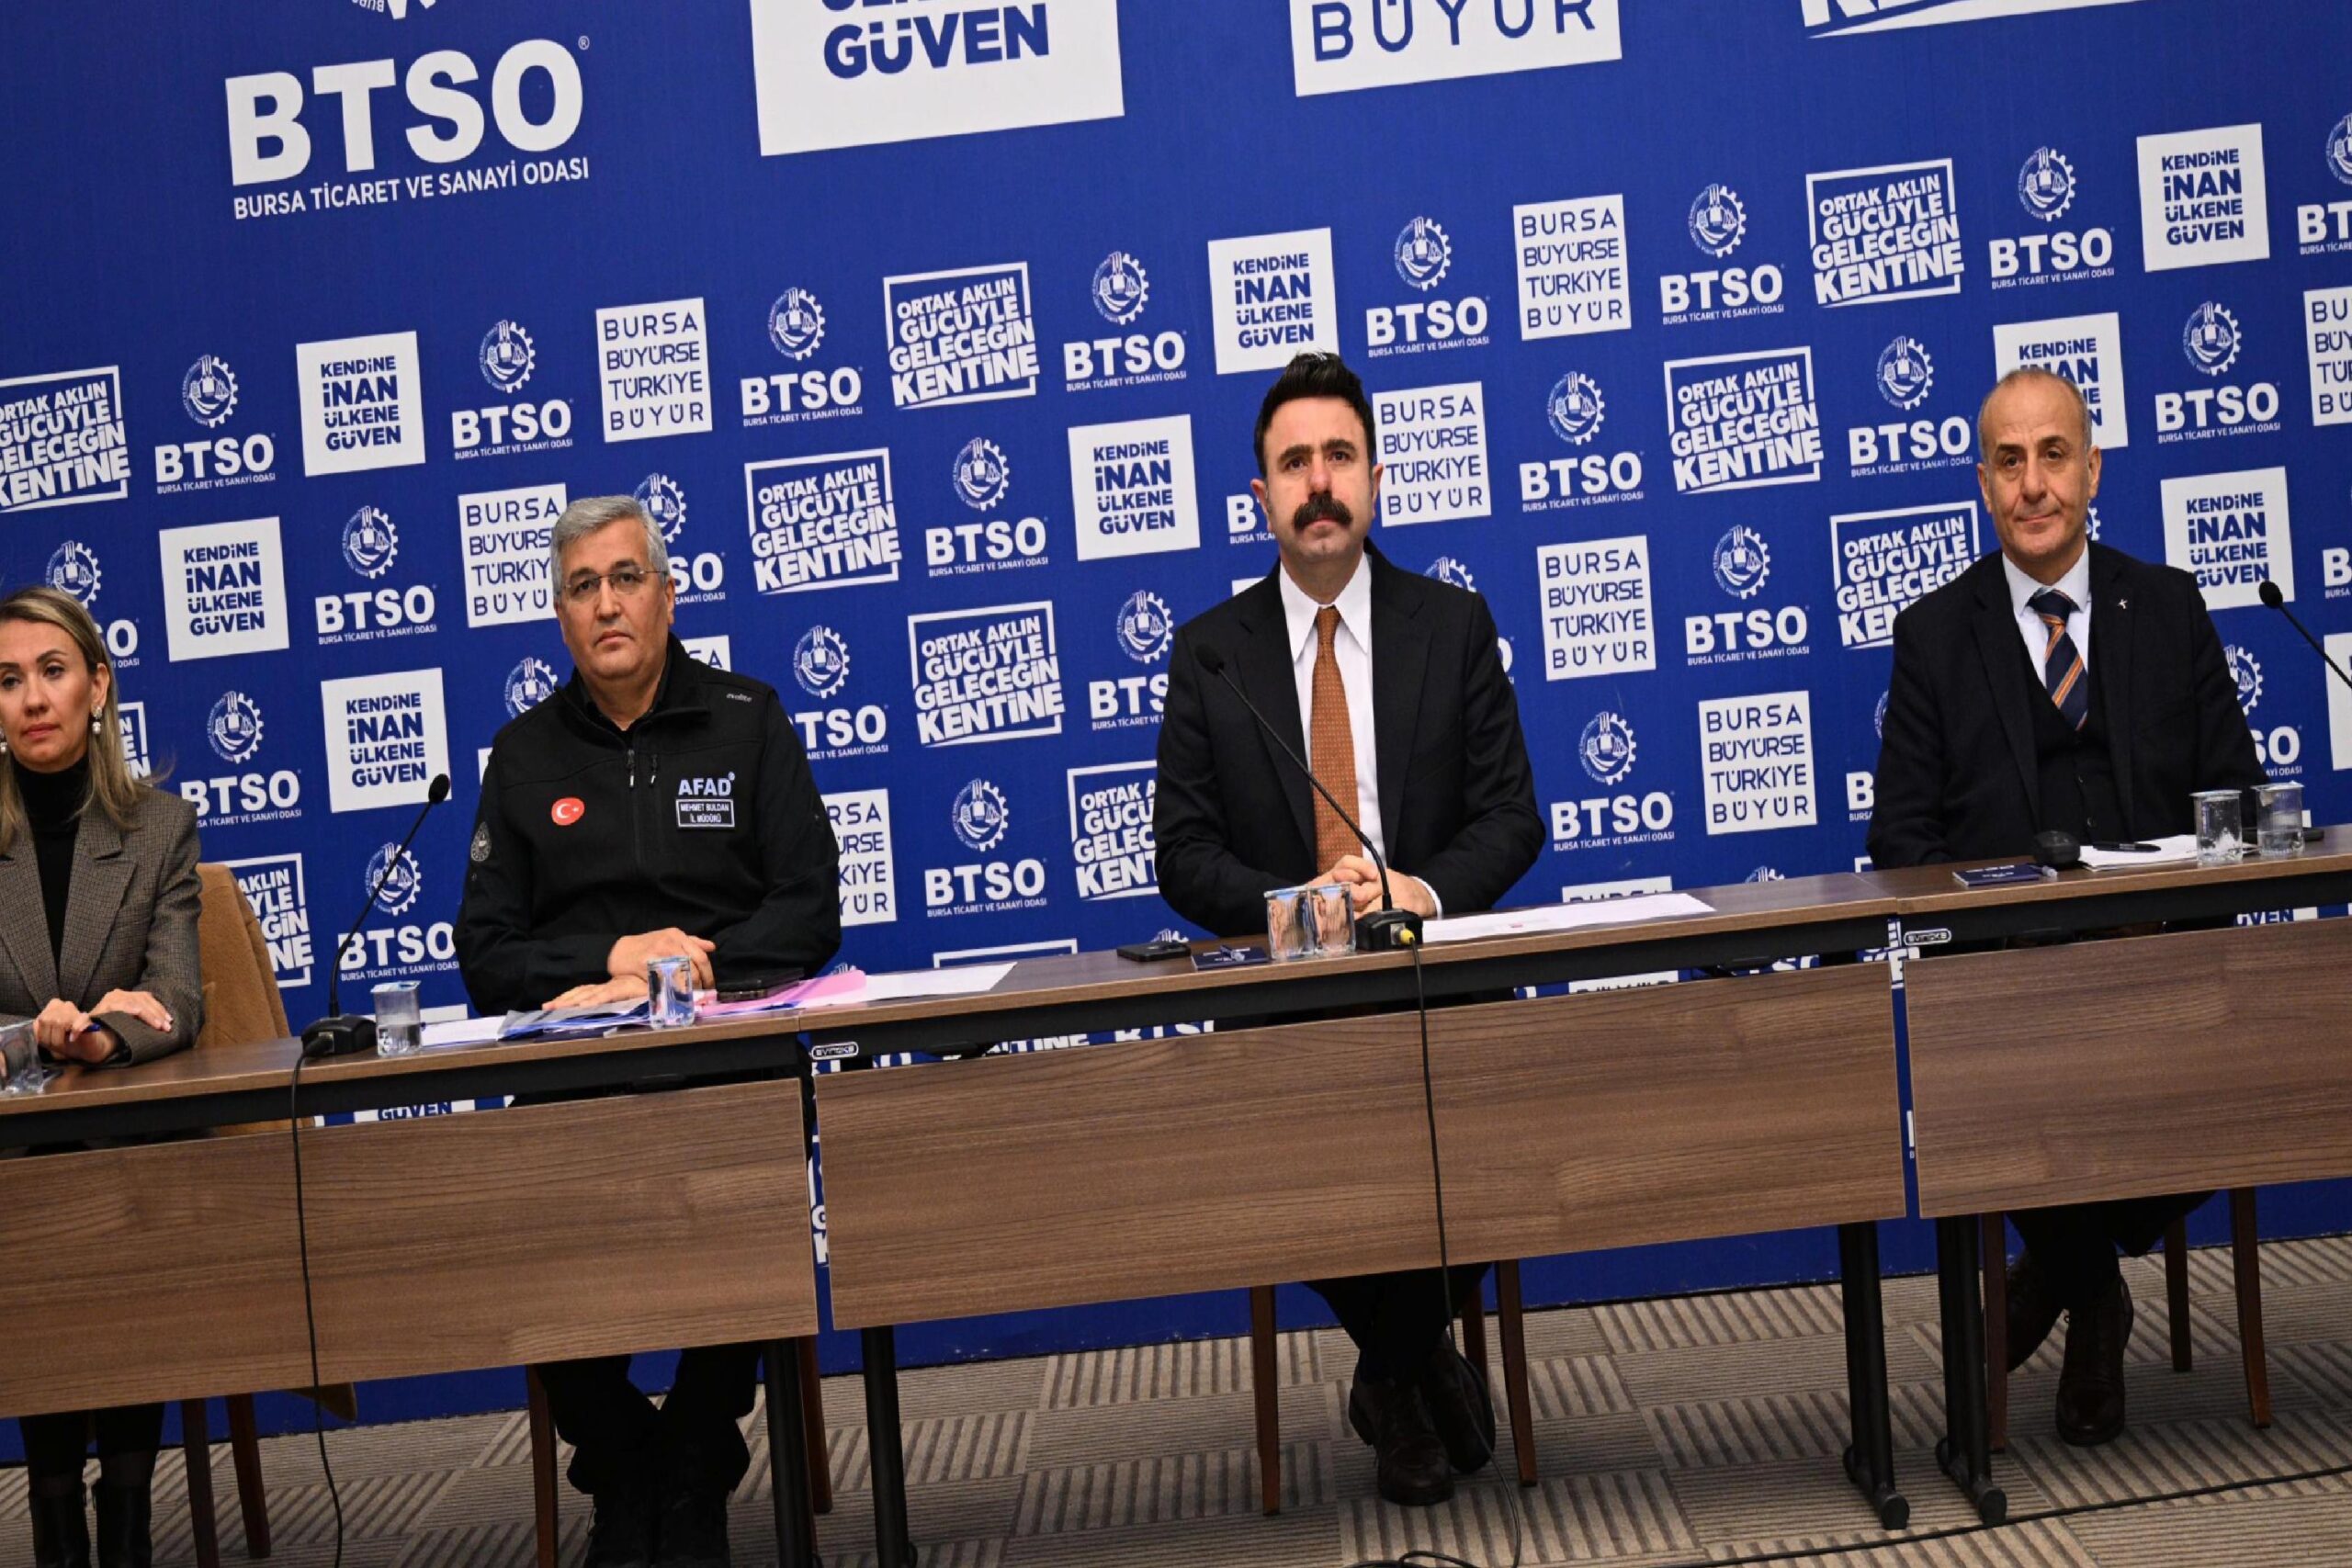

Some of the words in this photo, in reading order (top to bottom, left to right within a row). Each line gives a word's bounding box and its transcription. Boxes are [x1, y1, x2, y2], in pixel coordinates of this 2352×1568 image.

[824, 3, 1049, 79] GÜVEN
[225, 39, 583, 186] BTSO
[234, 192, 306, 220] BURSA
[311, 178, 401, 210] TİCARET
[407, 175, 434, 199] VE
[439, 160, 517, 196] SANAYİ
[524, 157, 589, 185] ODASI
[1820, 188, 1882, 216] ORTAK
[1886, 175, 1940, 201] AKLIN
[1522, 209, 1617, 238] BURSA
[2165, 198, 2242, 222] ÜLKENE
[2166, 220, 2244, 245] GÜVEN
[1524, 238, 1620, 267] BÜYÜRSE
[1989, 228, 2112, 277] BTSO
[898, 290, 957, 318] ORTAK
[962, 276, 1016, 303] AKLIN
[1660, 265, 1782, 313] BTSO
[605, 311, 698, 341] BURSA
[1237, 301, 1312, 326] ÜLKENE
[1366, 297, 1487, 346] BTSO
[1528, 299, 1623, 329] BÜYÜR
[1238, 321, 1314, 348] GÜVEN
[606, 341, 700, 370] BÜYÜRSE
[1064, 332, 1184, 380] BTSO
[54, 380, 107, 410] AKLIN
[741, 367, 861, 415] BTSO
[1067, 382, 1091, 391] BURSA
[1679, 376, 1739, 403] ORTAK
[1745, 362, 1799, 389] AKLIN
[324, 405, 399, 428] ÜLKENE
[610, 402, 704, 431] BÜYÜR
[1381, 396, 1476, 425] BURSA
[2154, 382, 2278, 432] BTSO
[326, 425, 401, 450] GÜVEN
[452, 400, 571, 448] BTSO
[2158, 434, 2183, 443] BURSA
[1383, 425, 1478, 454] BÜYÜRSE
[1849, 417, 1971, 466] BTSO
[154, 434, 274, 483] BTSO
[455, 450, 479, 459] BURSA
[759, 477, 819, 504] ORTAK
[823, 464, 877, 491] AKLIN
[1520, 452, 1642, 501] BTSO
[467, 497, 560, 526] BURSA
[1097, 489, 1173, 512] ÜLKENE
[1387, 486, 1482, 515] BÜYÜR
[1522, 502, 1547, 512] BURSA
[1581, 497, 1590, 505] VE
[1099, 510, 1174, 535] GÜVEN
[1845, 530, 1905, 558] ORTAK
[1910, 516, 1965, 543] AKLIN
[469, 528, 551, 556] BÜYÜRS
[925, 518, 1046, 566] BTSO
[2190, 542, 2267, 565] ÜLKENE
[929, 568, 953, 577] BURSA
[987, 562, 996, 570] VE
[1545, 549, 1641, 579] BURSA
[2194, 562, 2269, 588] GÜVEN
[188, 591, 263, 614] ÜLKENE
[1548, 579, 1644, 608] BÜYÜRSE
[189, 611, 265, 636] GÜVEN
[315, 585, 435, 634] BTSO
[922, 629, 982, 657] ORTAK
[987, 616, 1040, 643] AKLIN
[1685, 606, 1807, 654] BTSO
[1552, 640, 1647, 669] BÜYÜR
[1688, 656, 1713, 666] BURSA
[1089, 673, 1169, 719] BTS
[789, 705, 887, 749] TSO
[1707, 705, 1803, 733] BURSA
[350, 741, 424, 764] ÜLKENE
[1709, 734, 1804, 762] BÜYÜRSE
[352, 761, 426, 787] GÜVEN
[678, 778, 732, 796] AFAD
[681, 803, 705, 812] MEHMET
[1080, 783, 1141, 811] ORTAK
[1713, 795, 1808, 824] BÜYÜR
[1551, 792, 1673, 840] BTSO
[924, 859, 1045, 907] BTSO
[338, 921, 456, 970] BTSO
